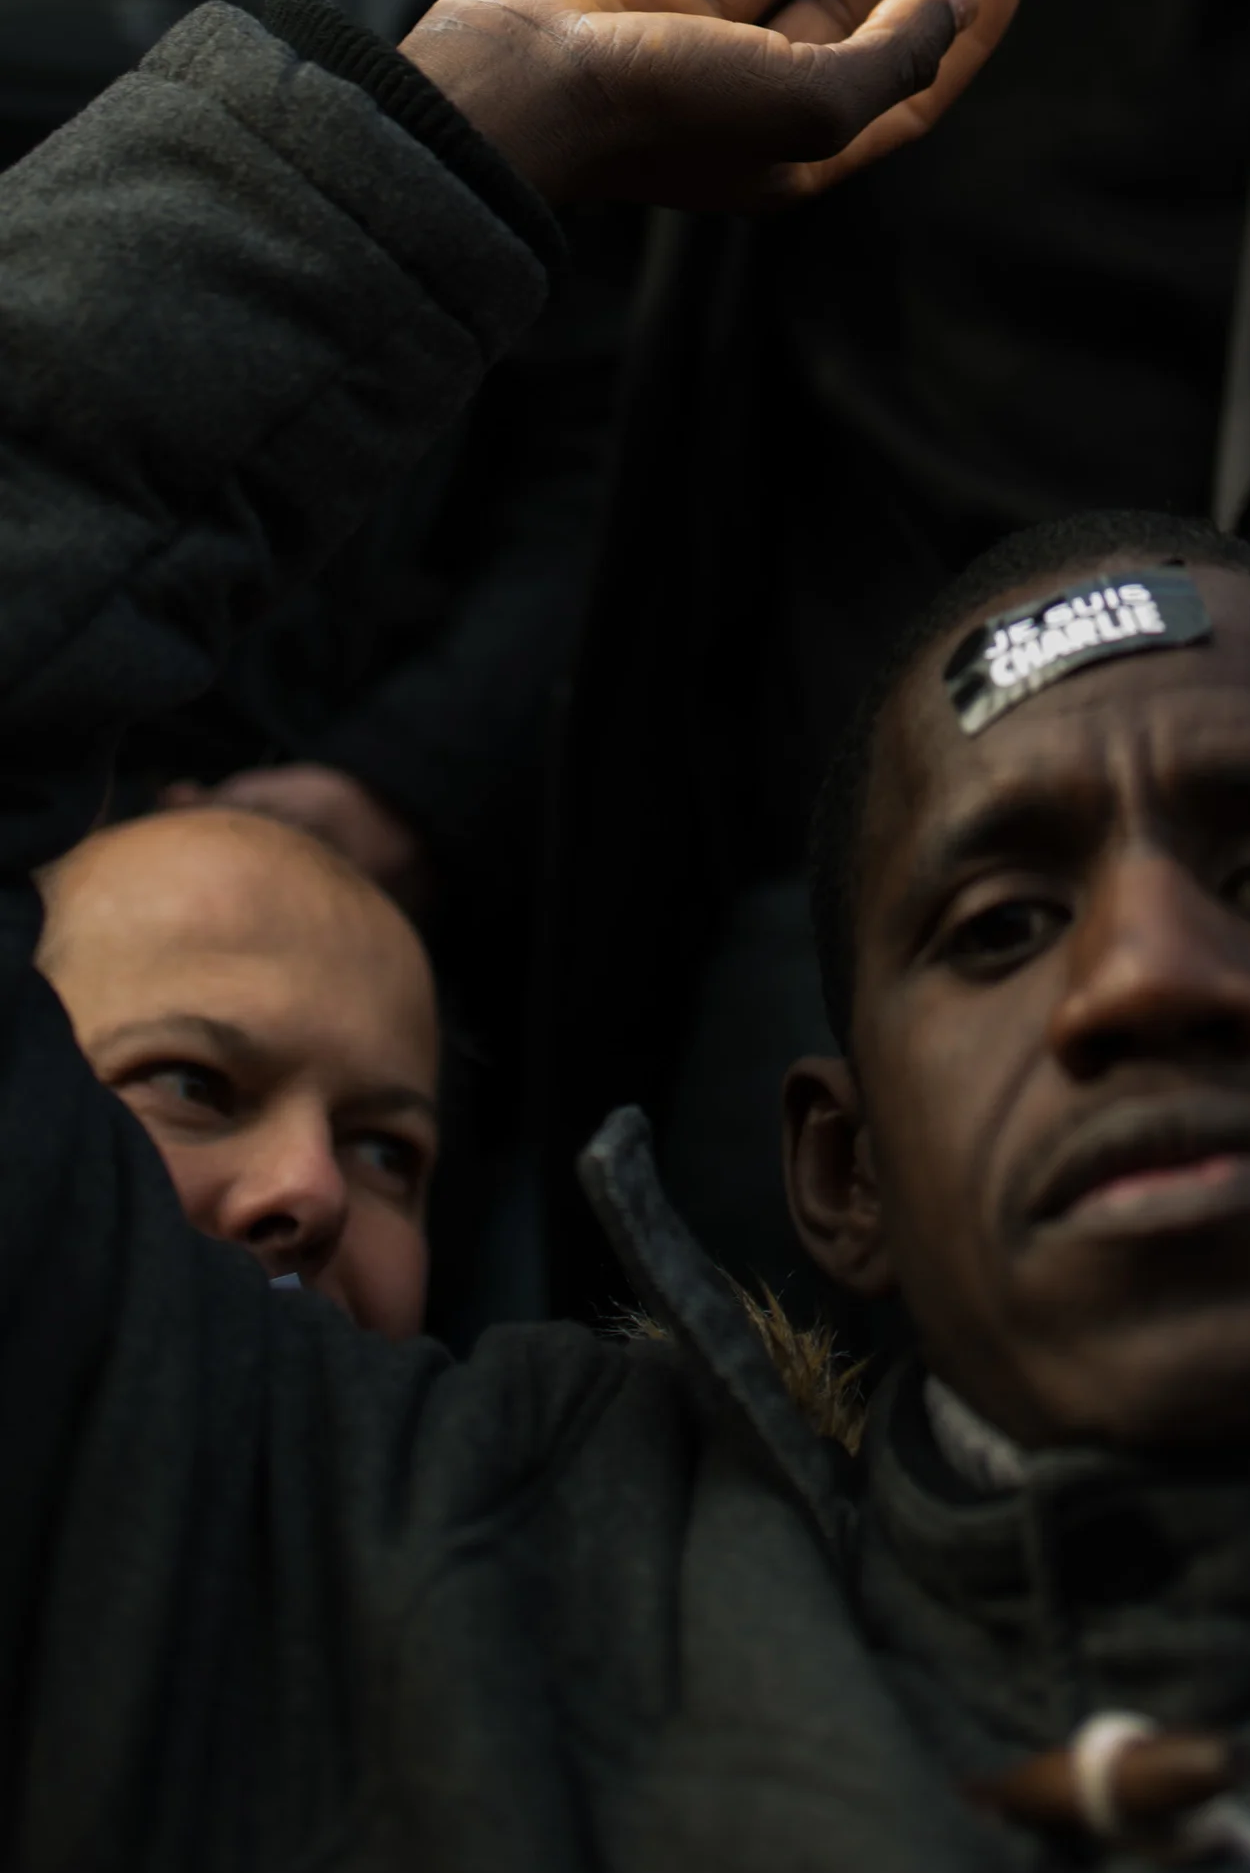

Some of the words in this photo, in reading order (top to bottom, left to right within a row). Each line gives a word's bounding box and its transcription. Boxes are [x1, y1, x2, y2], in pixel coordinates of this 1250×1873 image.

[984, 617, 1039, 660] JE
[1043, 583, 1151, 625] SUIS
[989, 600, 1167, 688] CHARLIE
